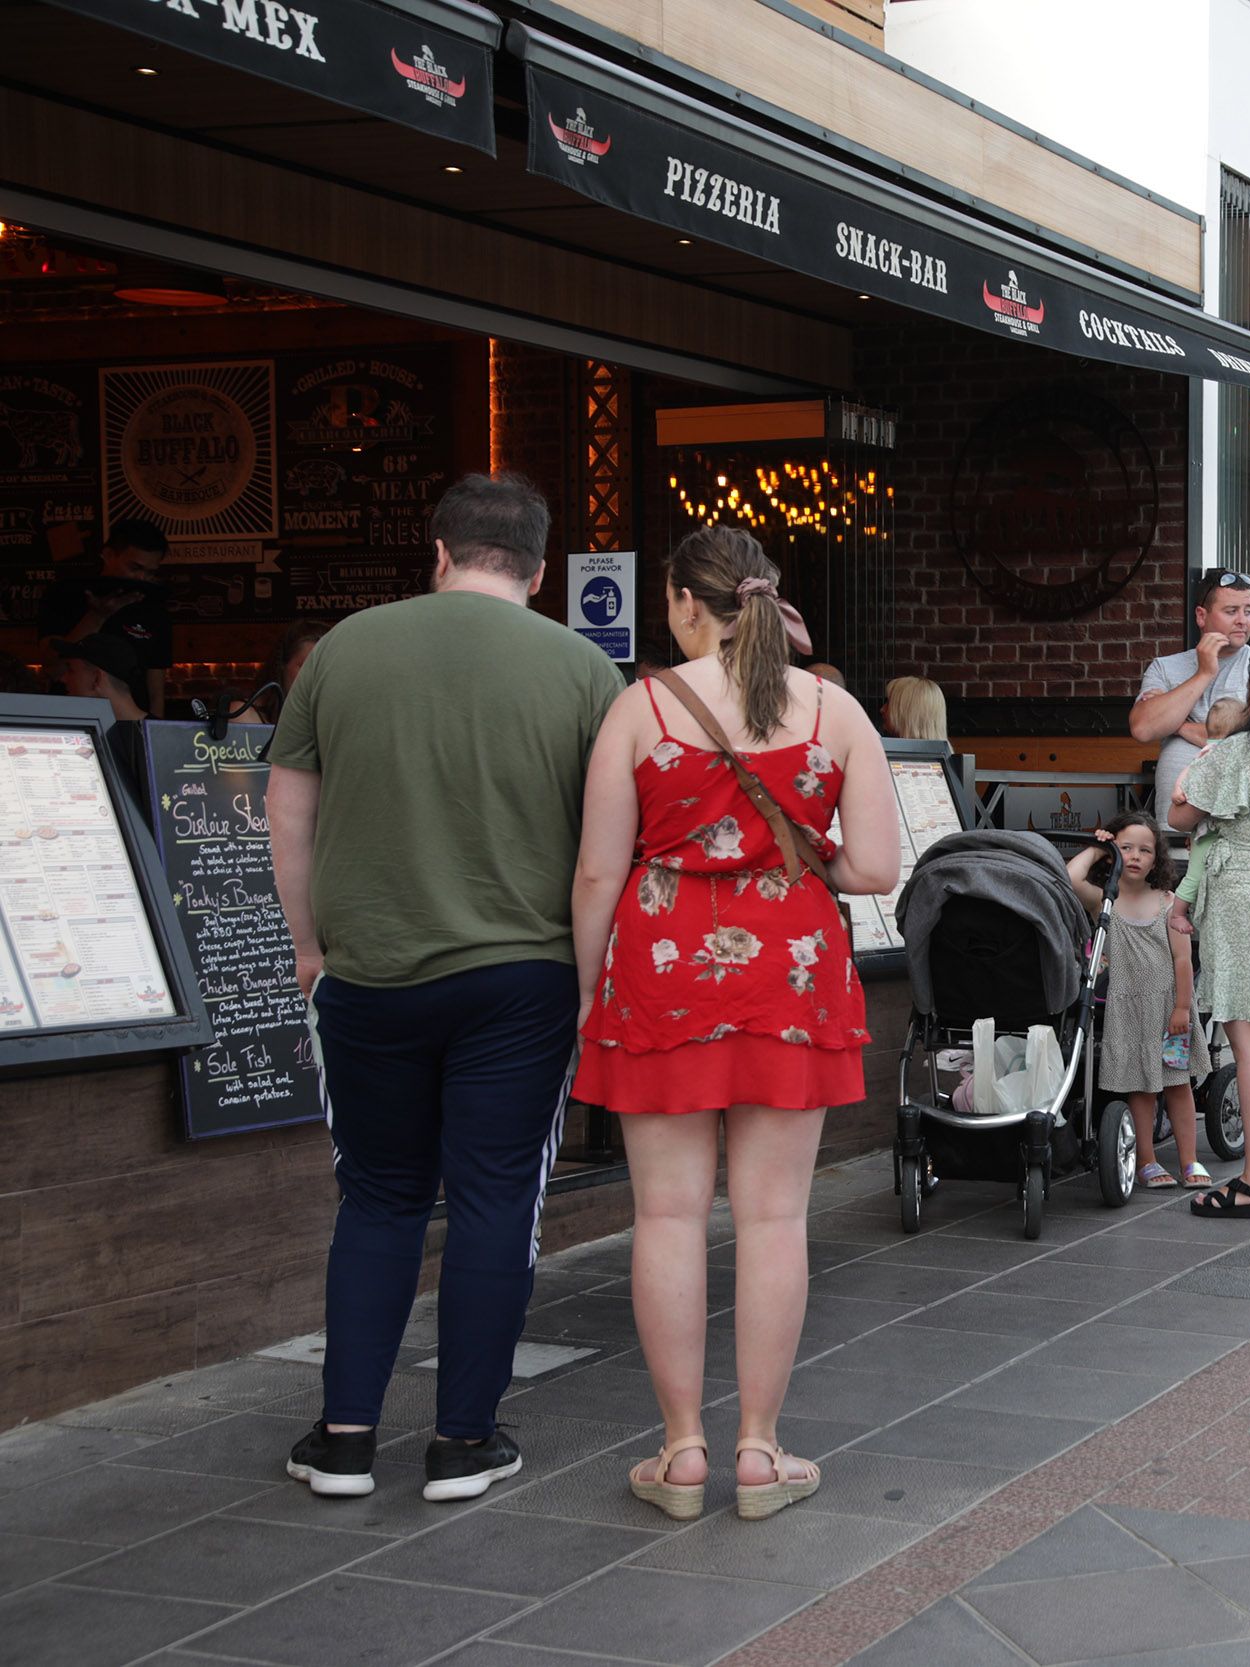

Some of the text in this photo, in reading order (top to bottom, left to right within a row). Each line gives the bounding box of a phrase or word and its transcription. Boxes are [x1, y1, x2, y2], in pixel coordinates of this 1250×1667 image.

[663, 156, 780, 235] PIZZERIA
[835, 221, 948, 293] SNACK-BAR
[1079, 309, 1186, 357] COCKTAILS
[297, 359, 417, 392] GRILLED HOUSE
[162, 412, 215, 433] BLACK
[136, 434, 240, 466] BUFFALO
[370, 480, 430, 501] MEAT
[284, 510, 361, 529] MOMENT
[597, 564, 622, 572] FAVOR
[207, 1051, 238, 1075] Sole
[240, 1044, 272, 1069] Fish
[225, 1075, 244, 1092] with
[247, 1074, 274, 1089] salad
